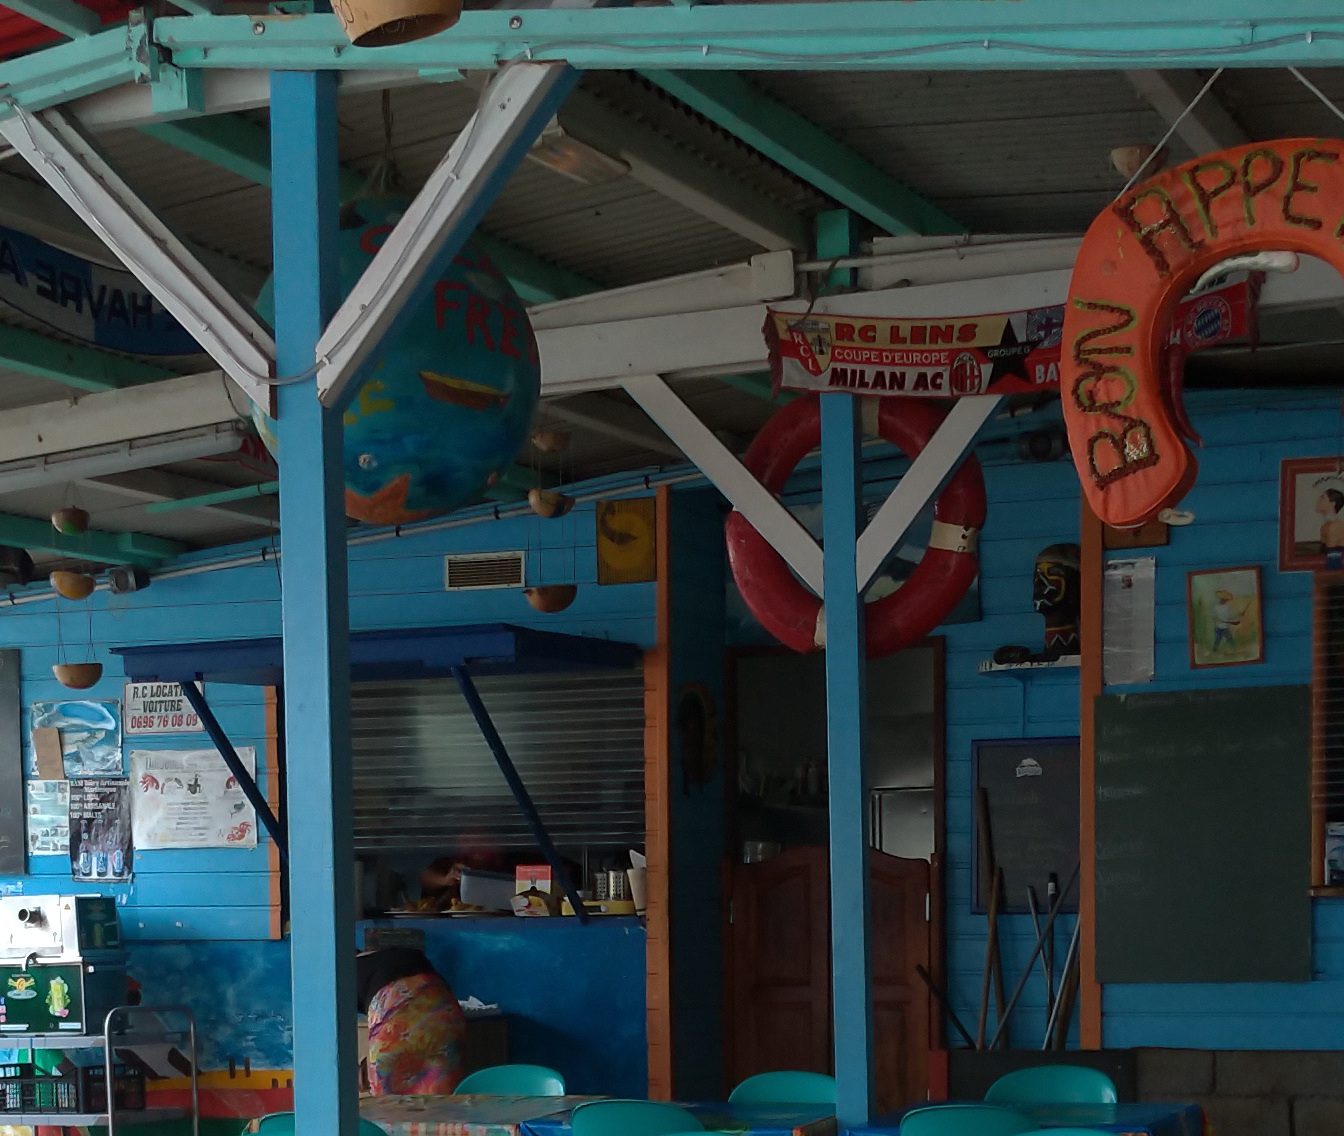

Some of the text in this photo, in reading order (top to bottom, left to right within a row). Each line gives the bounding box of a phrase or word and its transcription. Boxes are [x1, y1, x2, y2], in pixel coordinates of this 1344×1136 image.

[834, 322, 978, 345] RC LENS
[834, 348, 950, 365] COUPE D'EUROPE
[987, 346, 1022, 359] GROUPE
[828, 366, 945, 392] MILAN AC
[1071, 296, 1161, 489] BON
[150, 684, 183, 698] LOCATI
[143, 699, 184, 713] VOITURE
[131, 714, 155, 729] 0696
